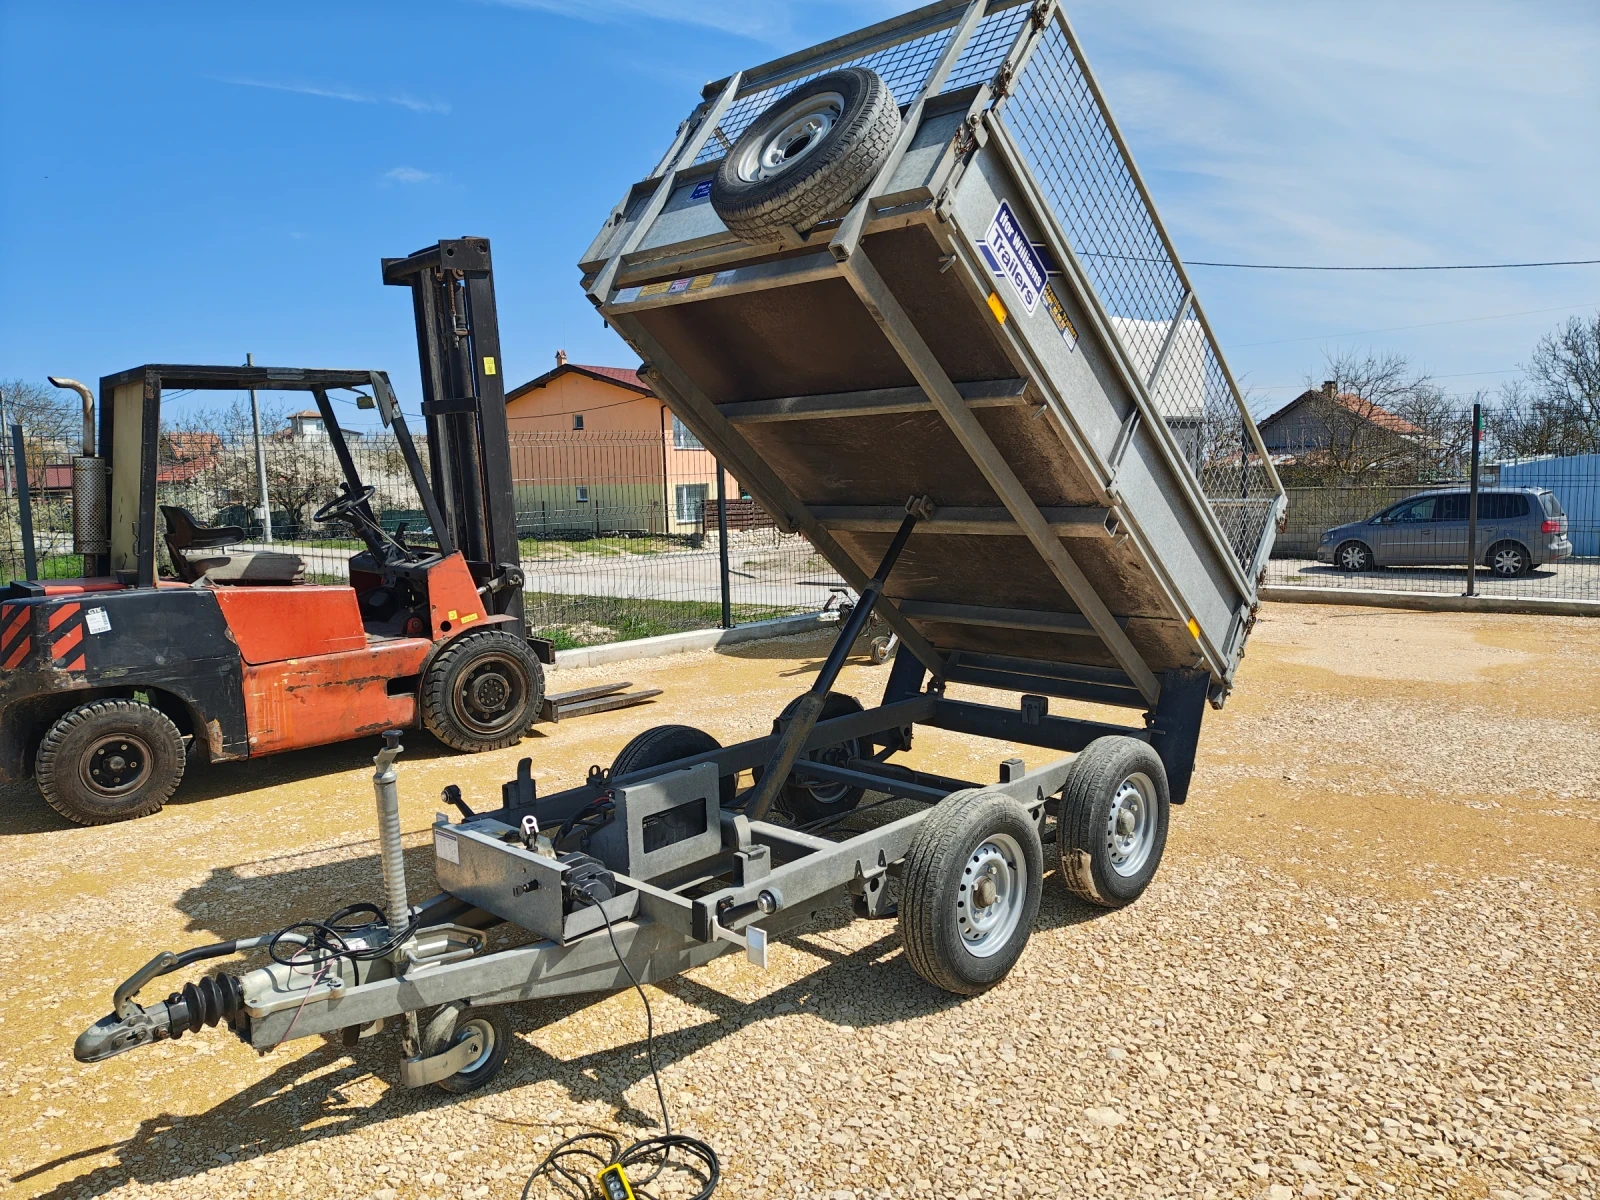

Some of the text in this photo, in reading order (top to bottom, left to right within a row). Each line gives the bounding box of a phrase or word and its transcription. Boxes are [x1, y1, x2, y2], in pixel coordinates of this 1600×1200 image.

[993, 228, 1034, 305] Trailers
[1000, 210, 1042, 287] Ifor Williams
